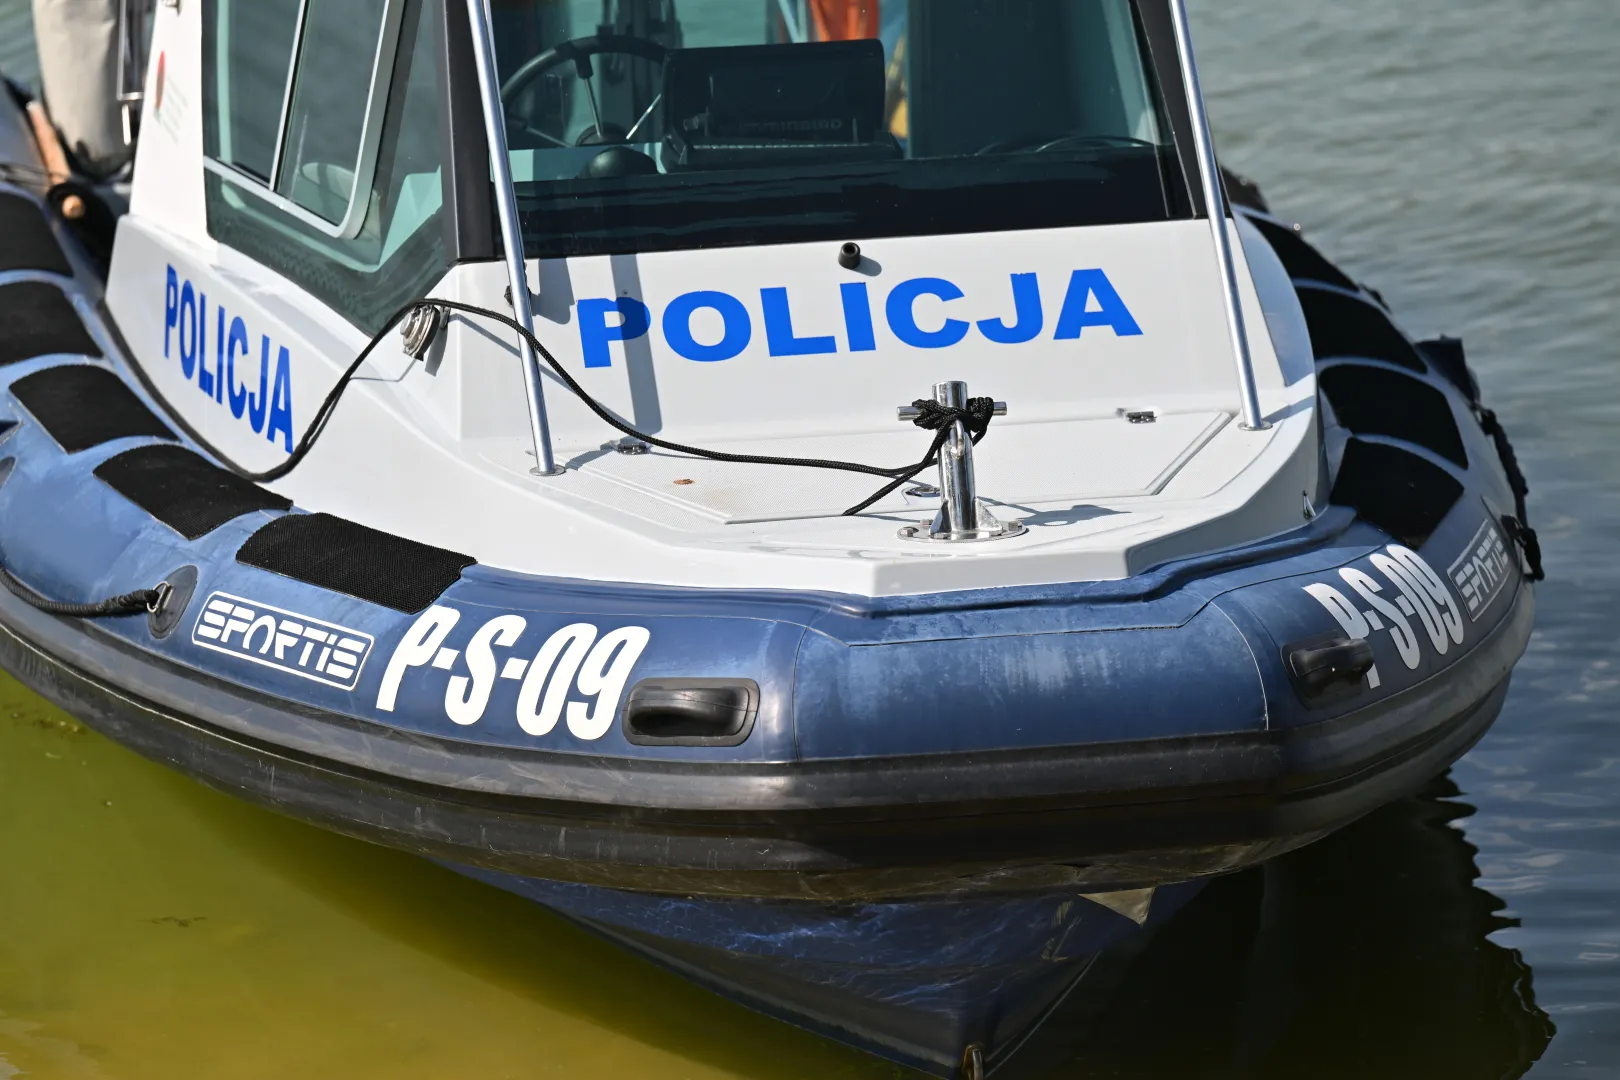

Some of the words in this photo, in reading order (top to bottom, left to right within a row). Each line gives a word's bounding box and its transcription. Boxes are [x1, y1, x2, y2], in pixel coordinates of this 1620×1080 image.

[164, 263, 293, 454] POLICJA
[577, 268, 1144, 368] POLICJA
[197, 599, 366, 680] SPORTIS
[376, 604, 650, 740] P-S-09
[1302, 544, 1464, 689] P-S-09
